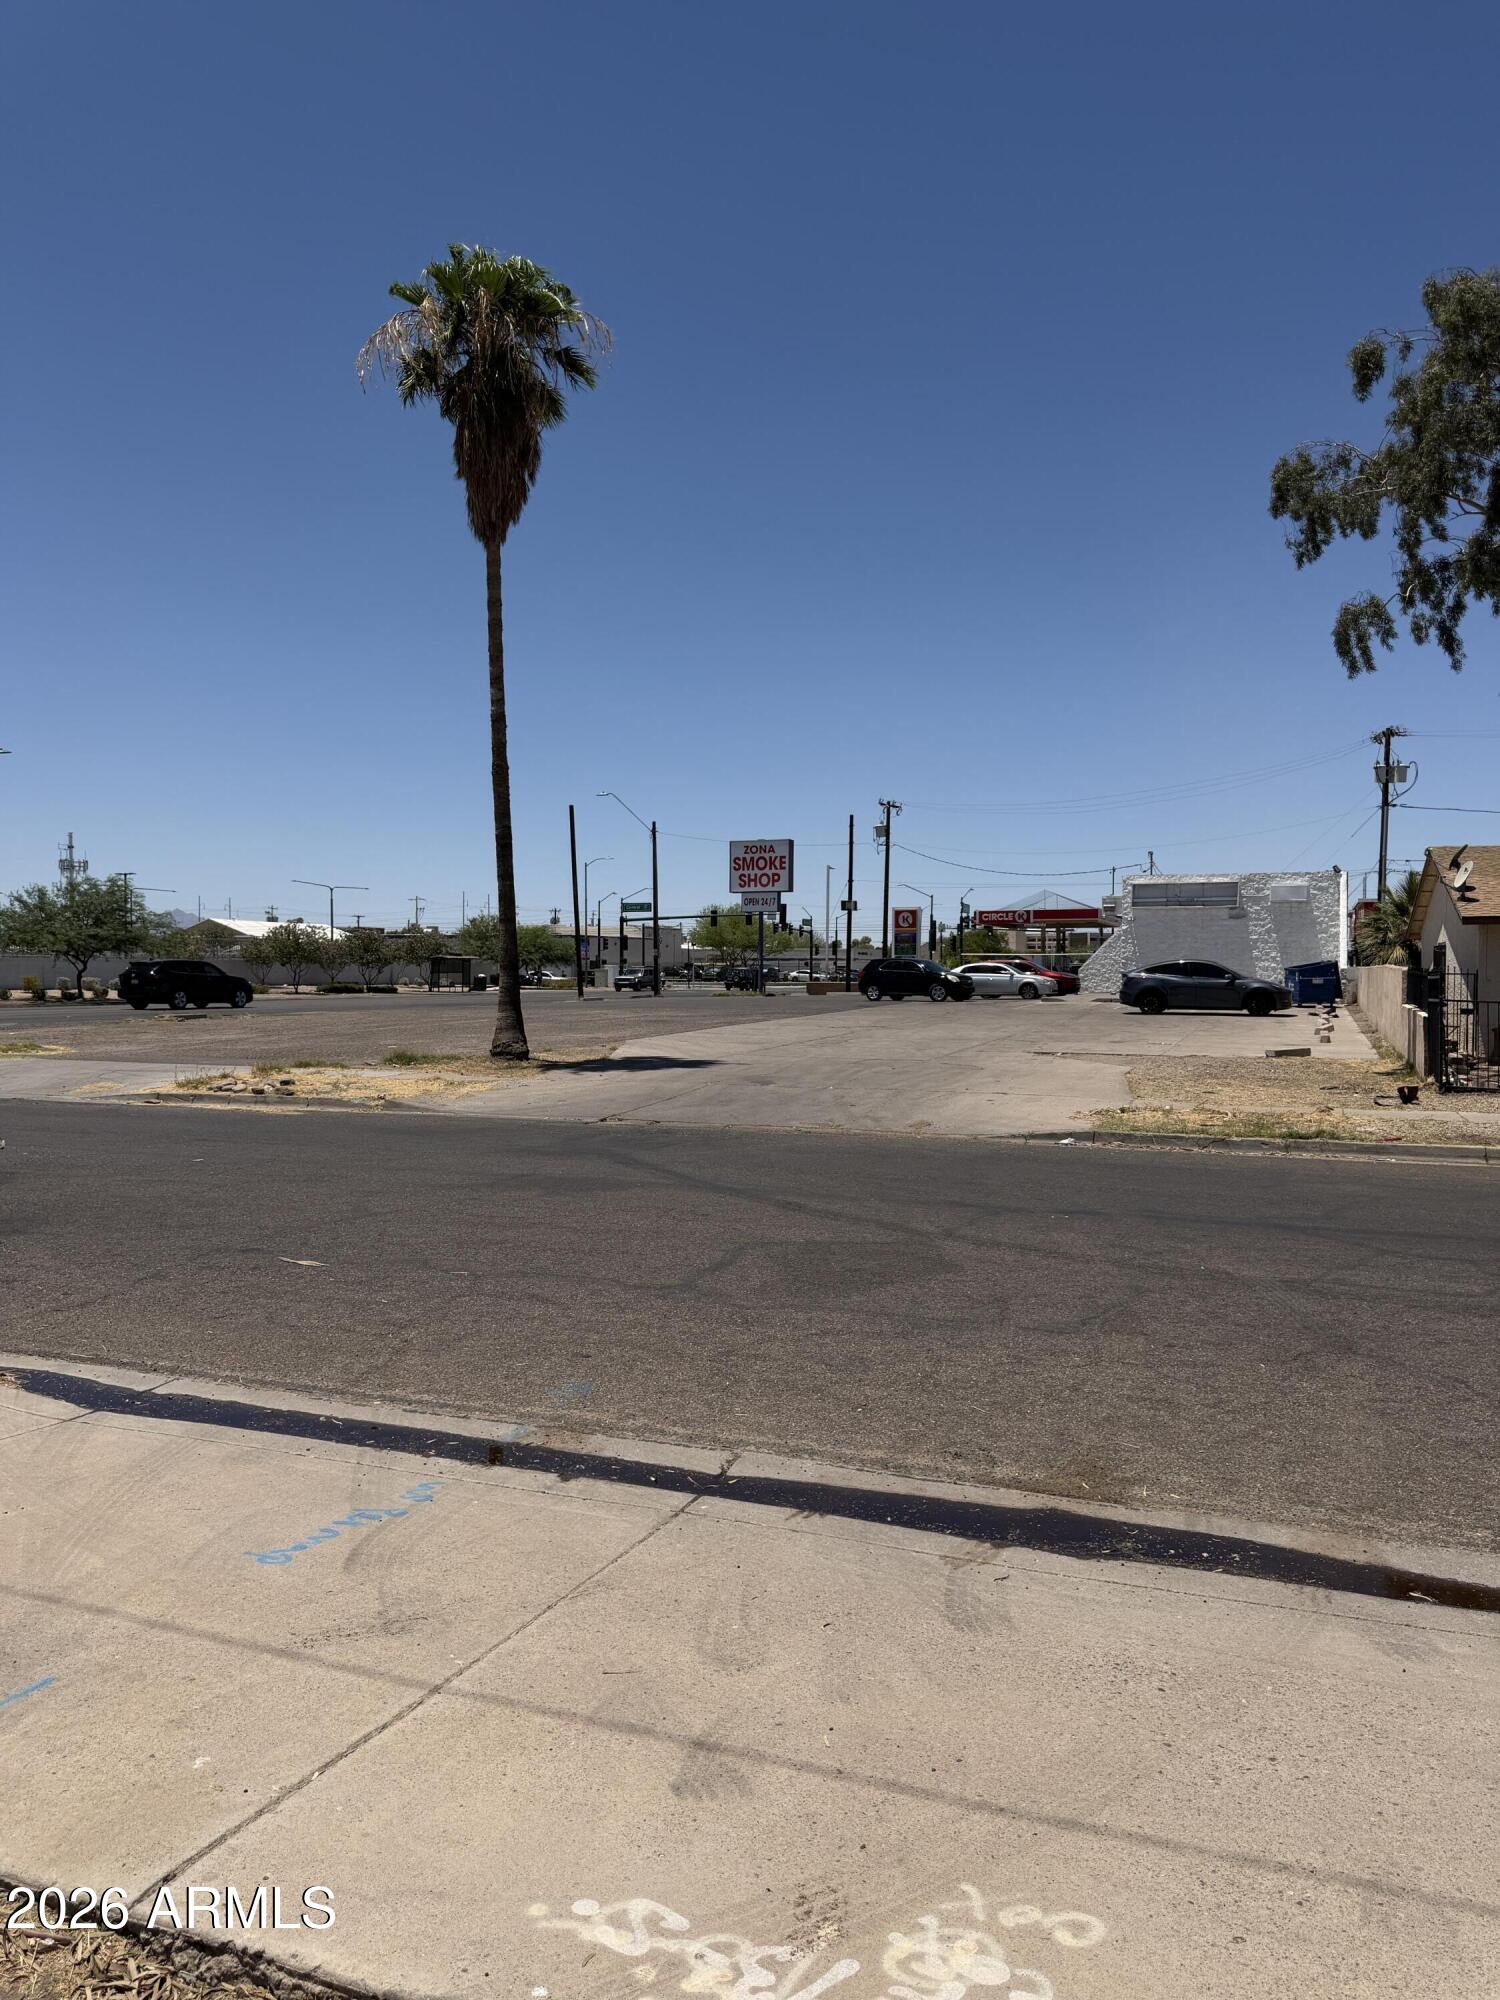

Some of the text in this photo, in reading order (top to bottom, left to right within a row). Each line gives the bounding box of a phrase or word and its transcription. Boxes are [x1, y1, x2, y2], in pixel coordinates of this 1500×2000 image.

[743, 845, 776, 854] ZONA
[733, 856, 786, 871] SMOKE
[738, 872, 781, 888] SHOP
[743, 897, 776, 908] OPEN 24/7
[982, 911, 1014, 921] CIRCLE
